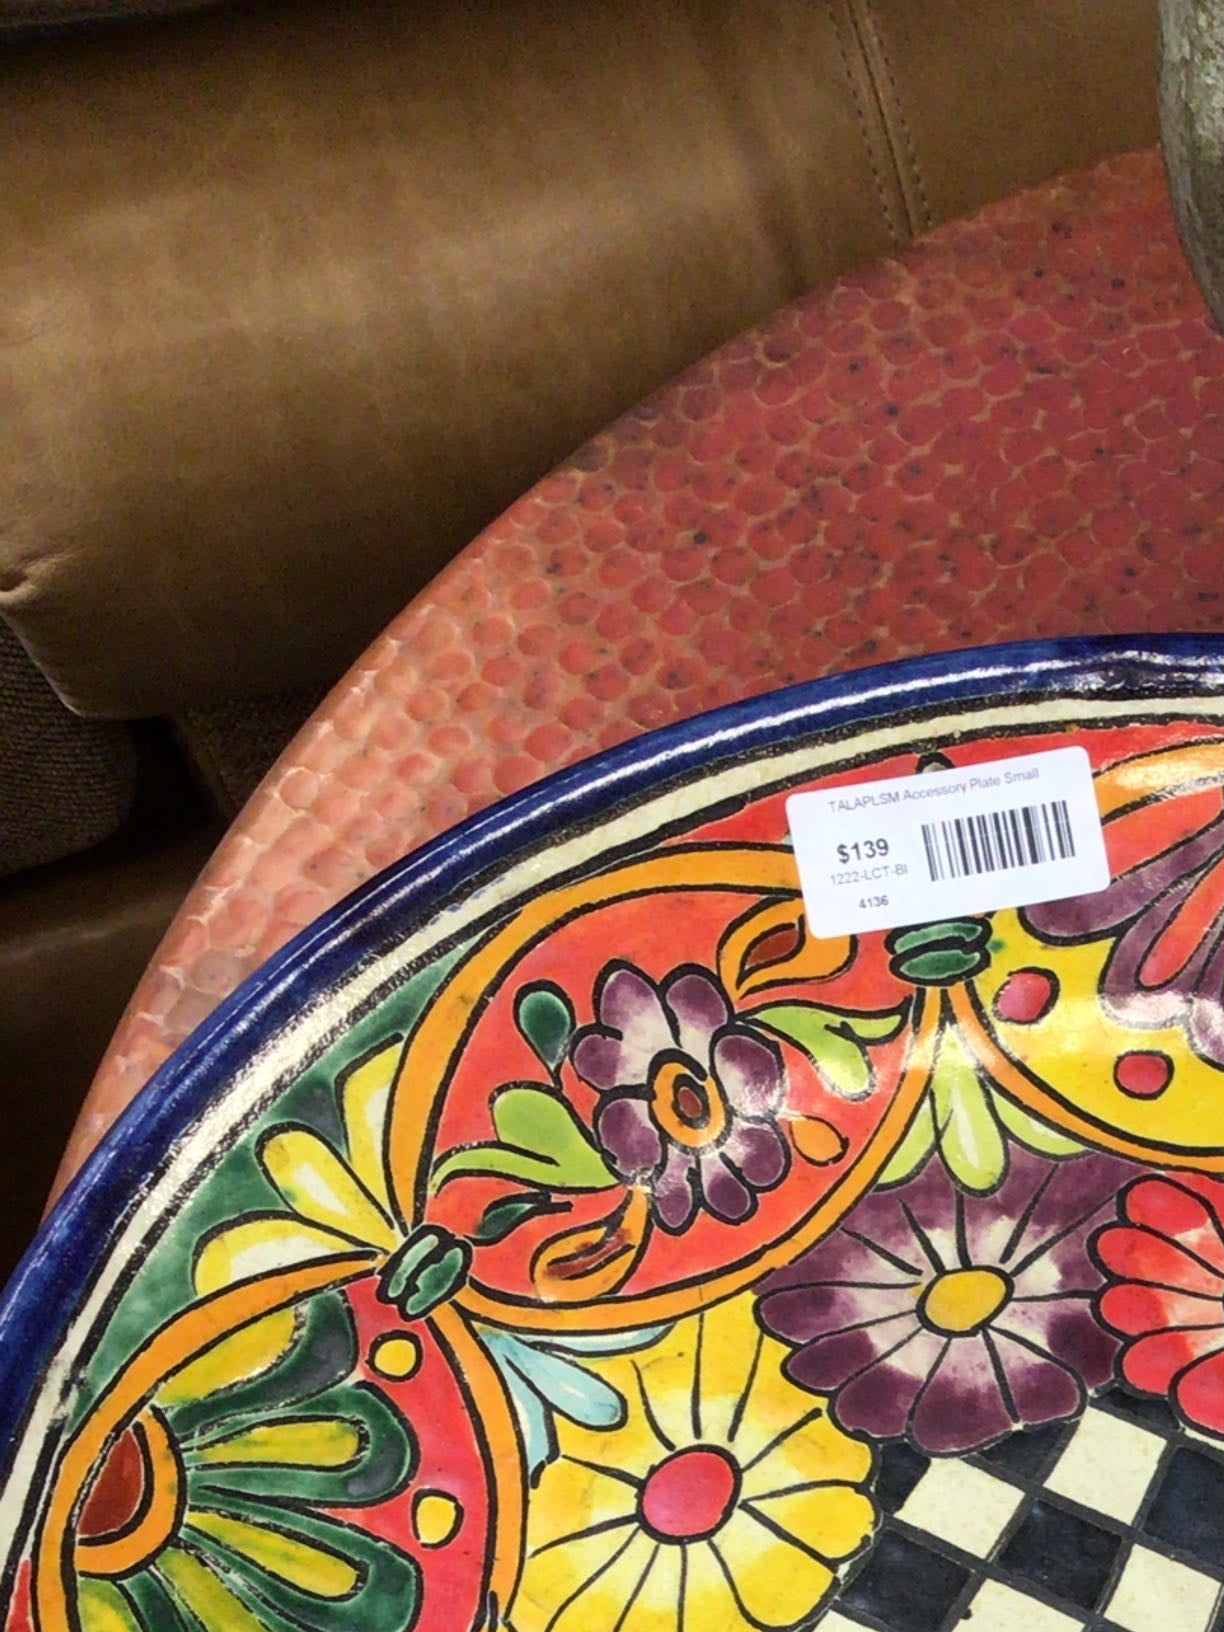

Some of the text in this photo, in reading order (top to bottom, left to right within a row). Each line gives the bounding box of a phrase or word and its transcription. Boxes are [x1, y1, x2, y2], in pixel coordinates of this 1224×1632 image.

[828, 767, 1039, 813] TALAPLSM Accessory Plate Small
[836, 838, 889, 864] $139
[859, 894, 889, 909] 4136
